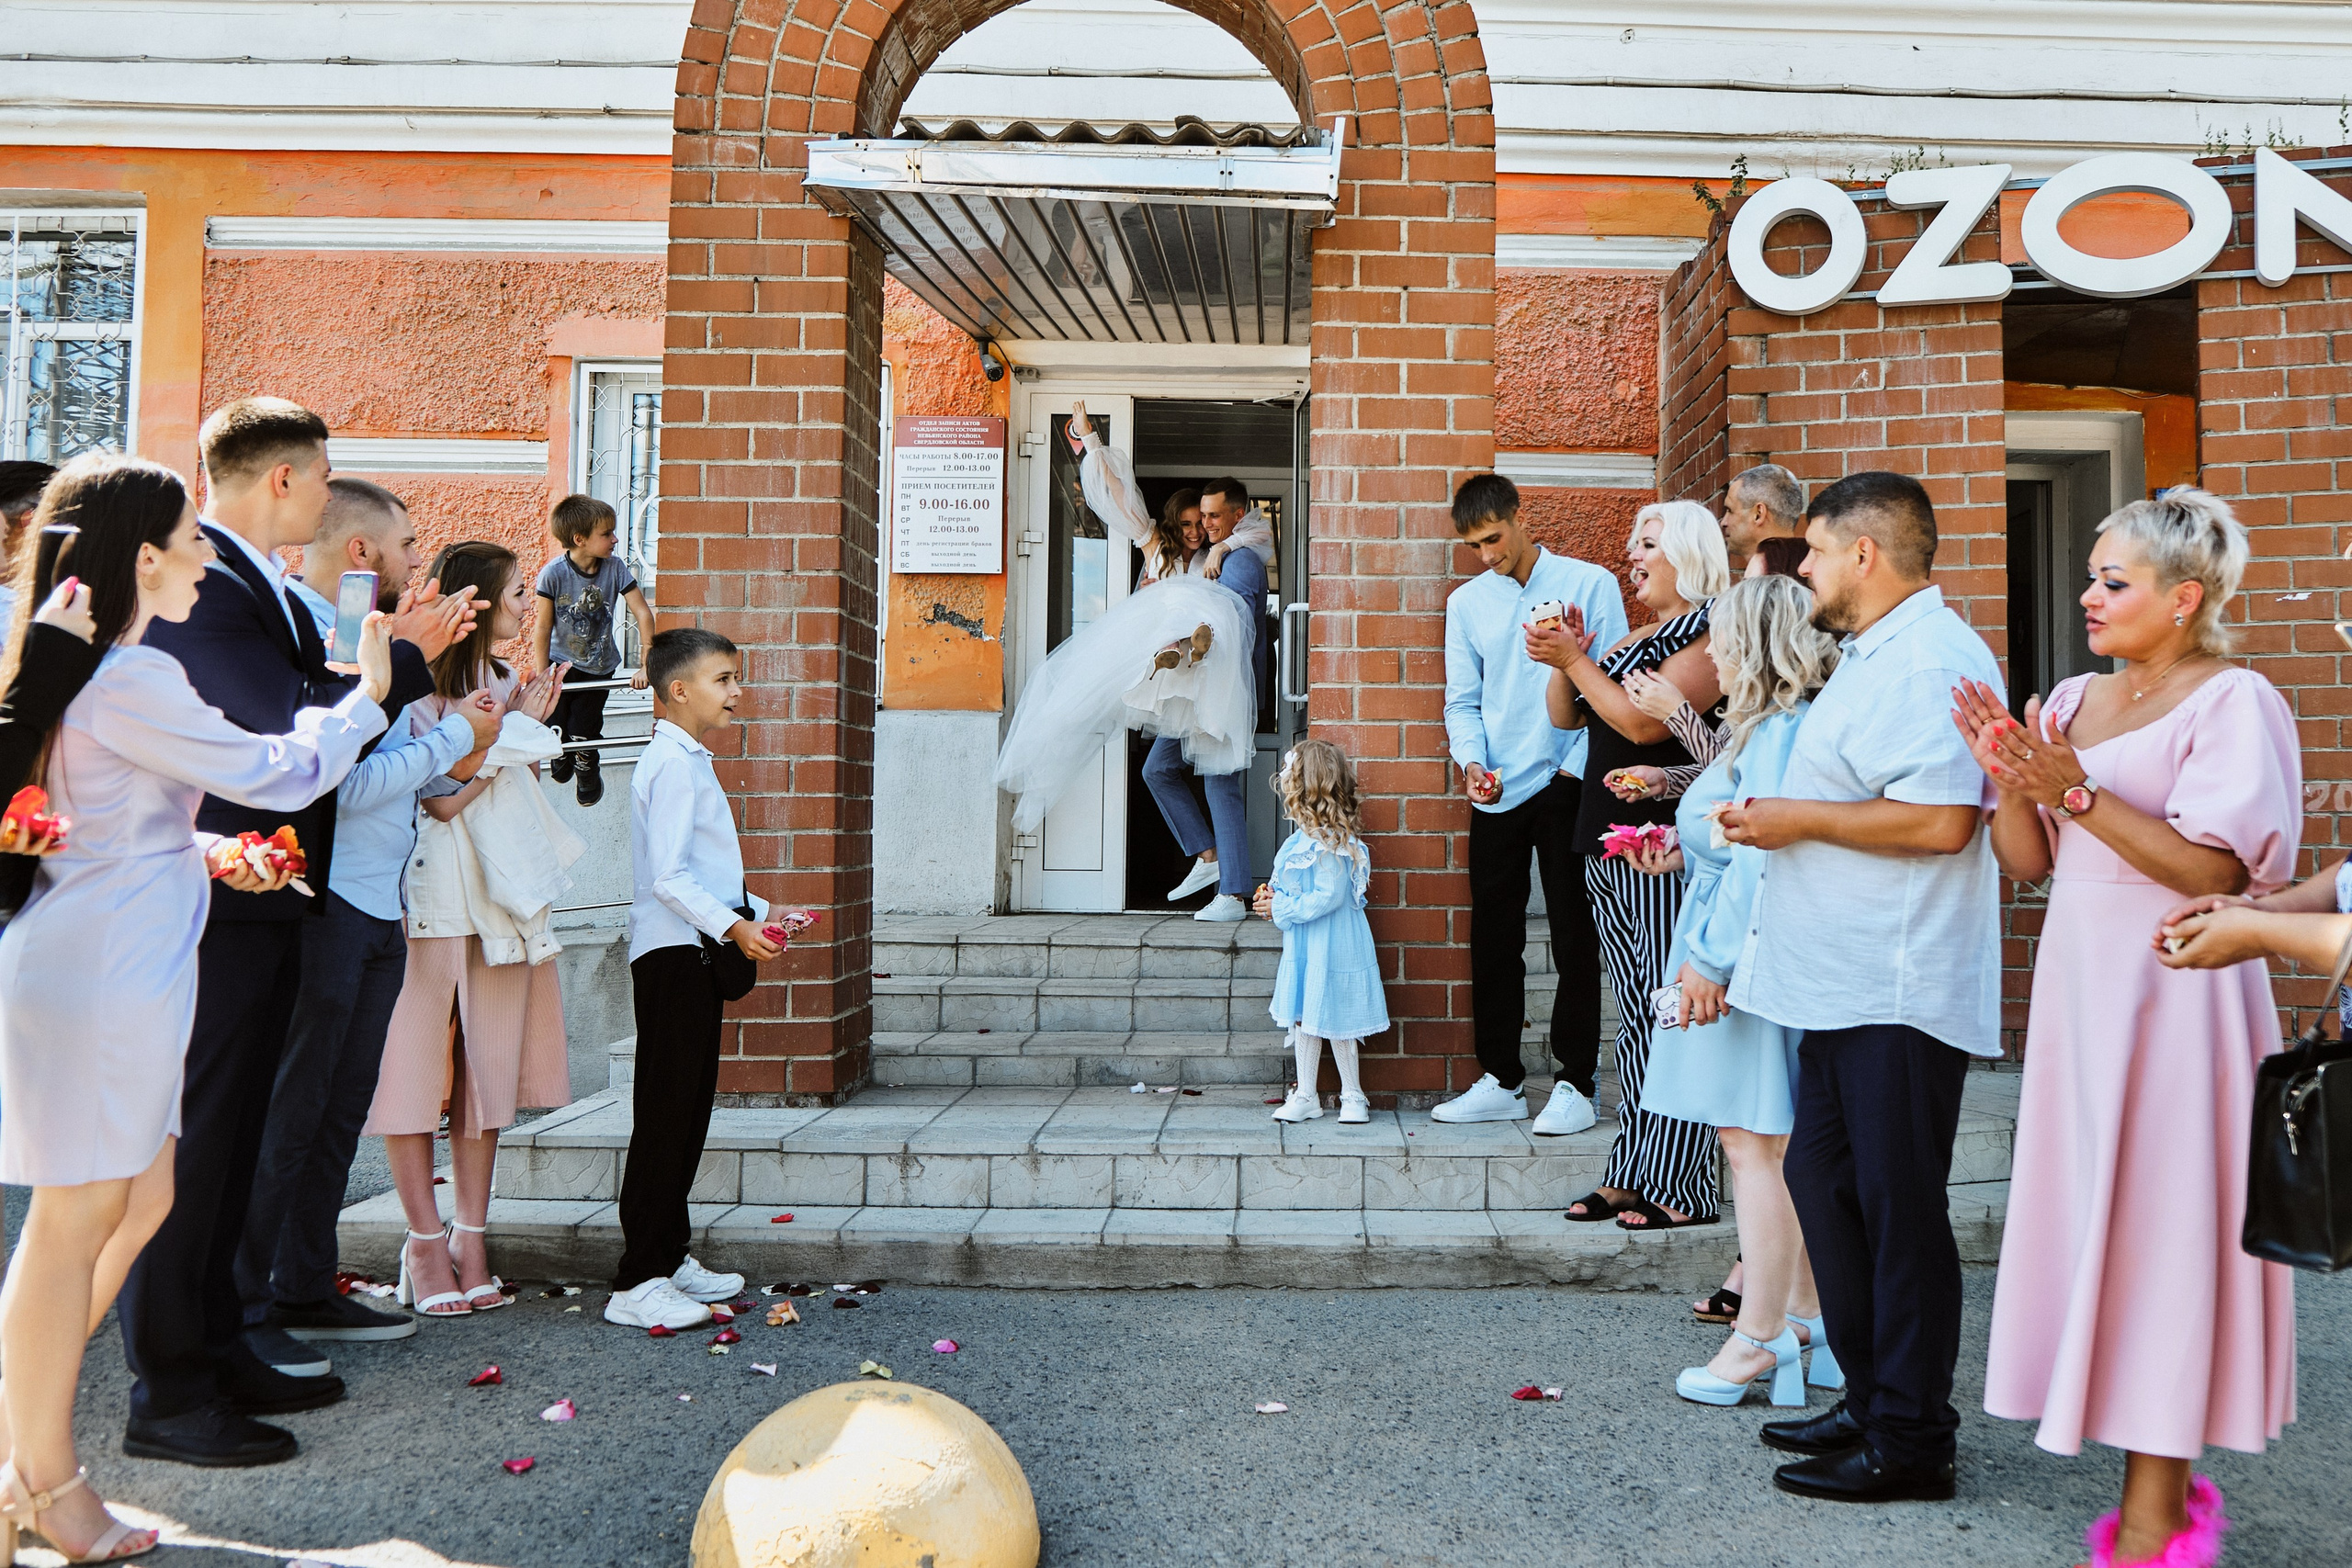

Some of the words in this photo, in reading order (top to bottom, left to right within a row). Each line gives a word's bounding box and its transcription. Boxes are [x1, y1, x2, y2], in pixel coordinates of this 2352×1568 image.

[953, 452, 999, 460] 8.00-17.00
[907, 465, 936, 473] Перерыв
[943, 464, 990, 472] 12.00-13.00
[933, 482, 995, 491] ПОСЕТИТЕЛЕЙ
[919, 498, 990, 511] 9.00-16.00
[938, 515, 971, 524] Перерыв
[929, 525, 979, 534] 12.00-13.00
